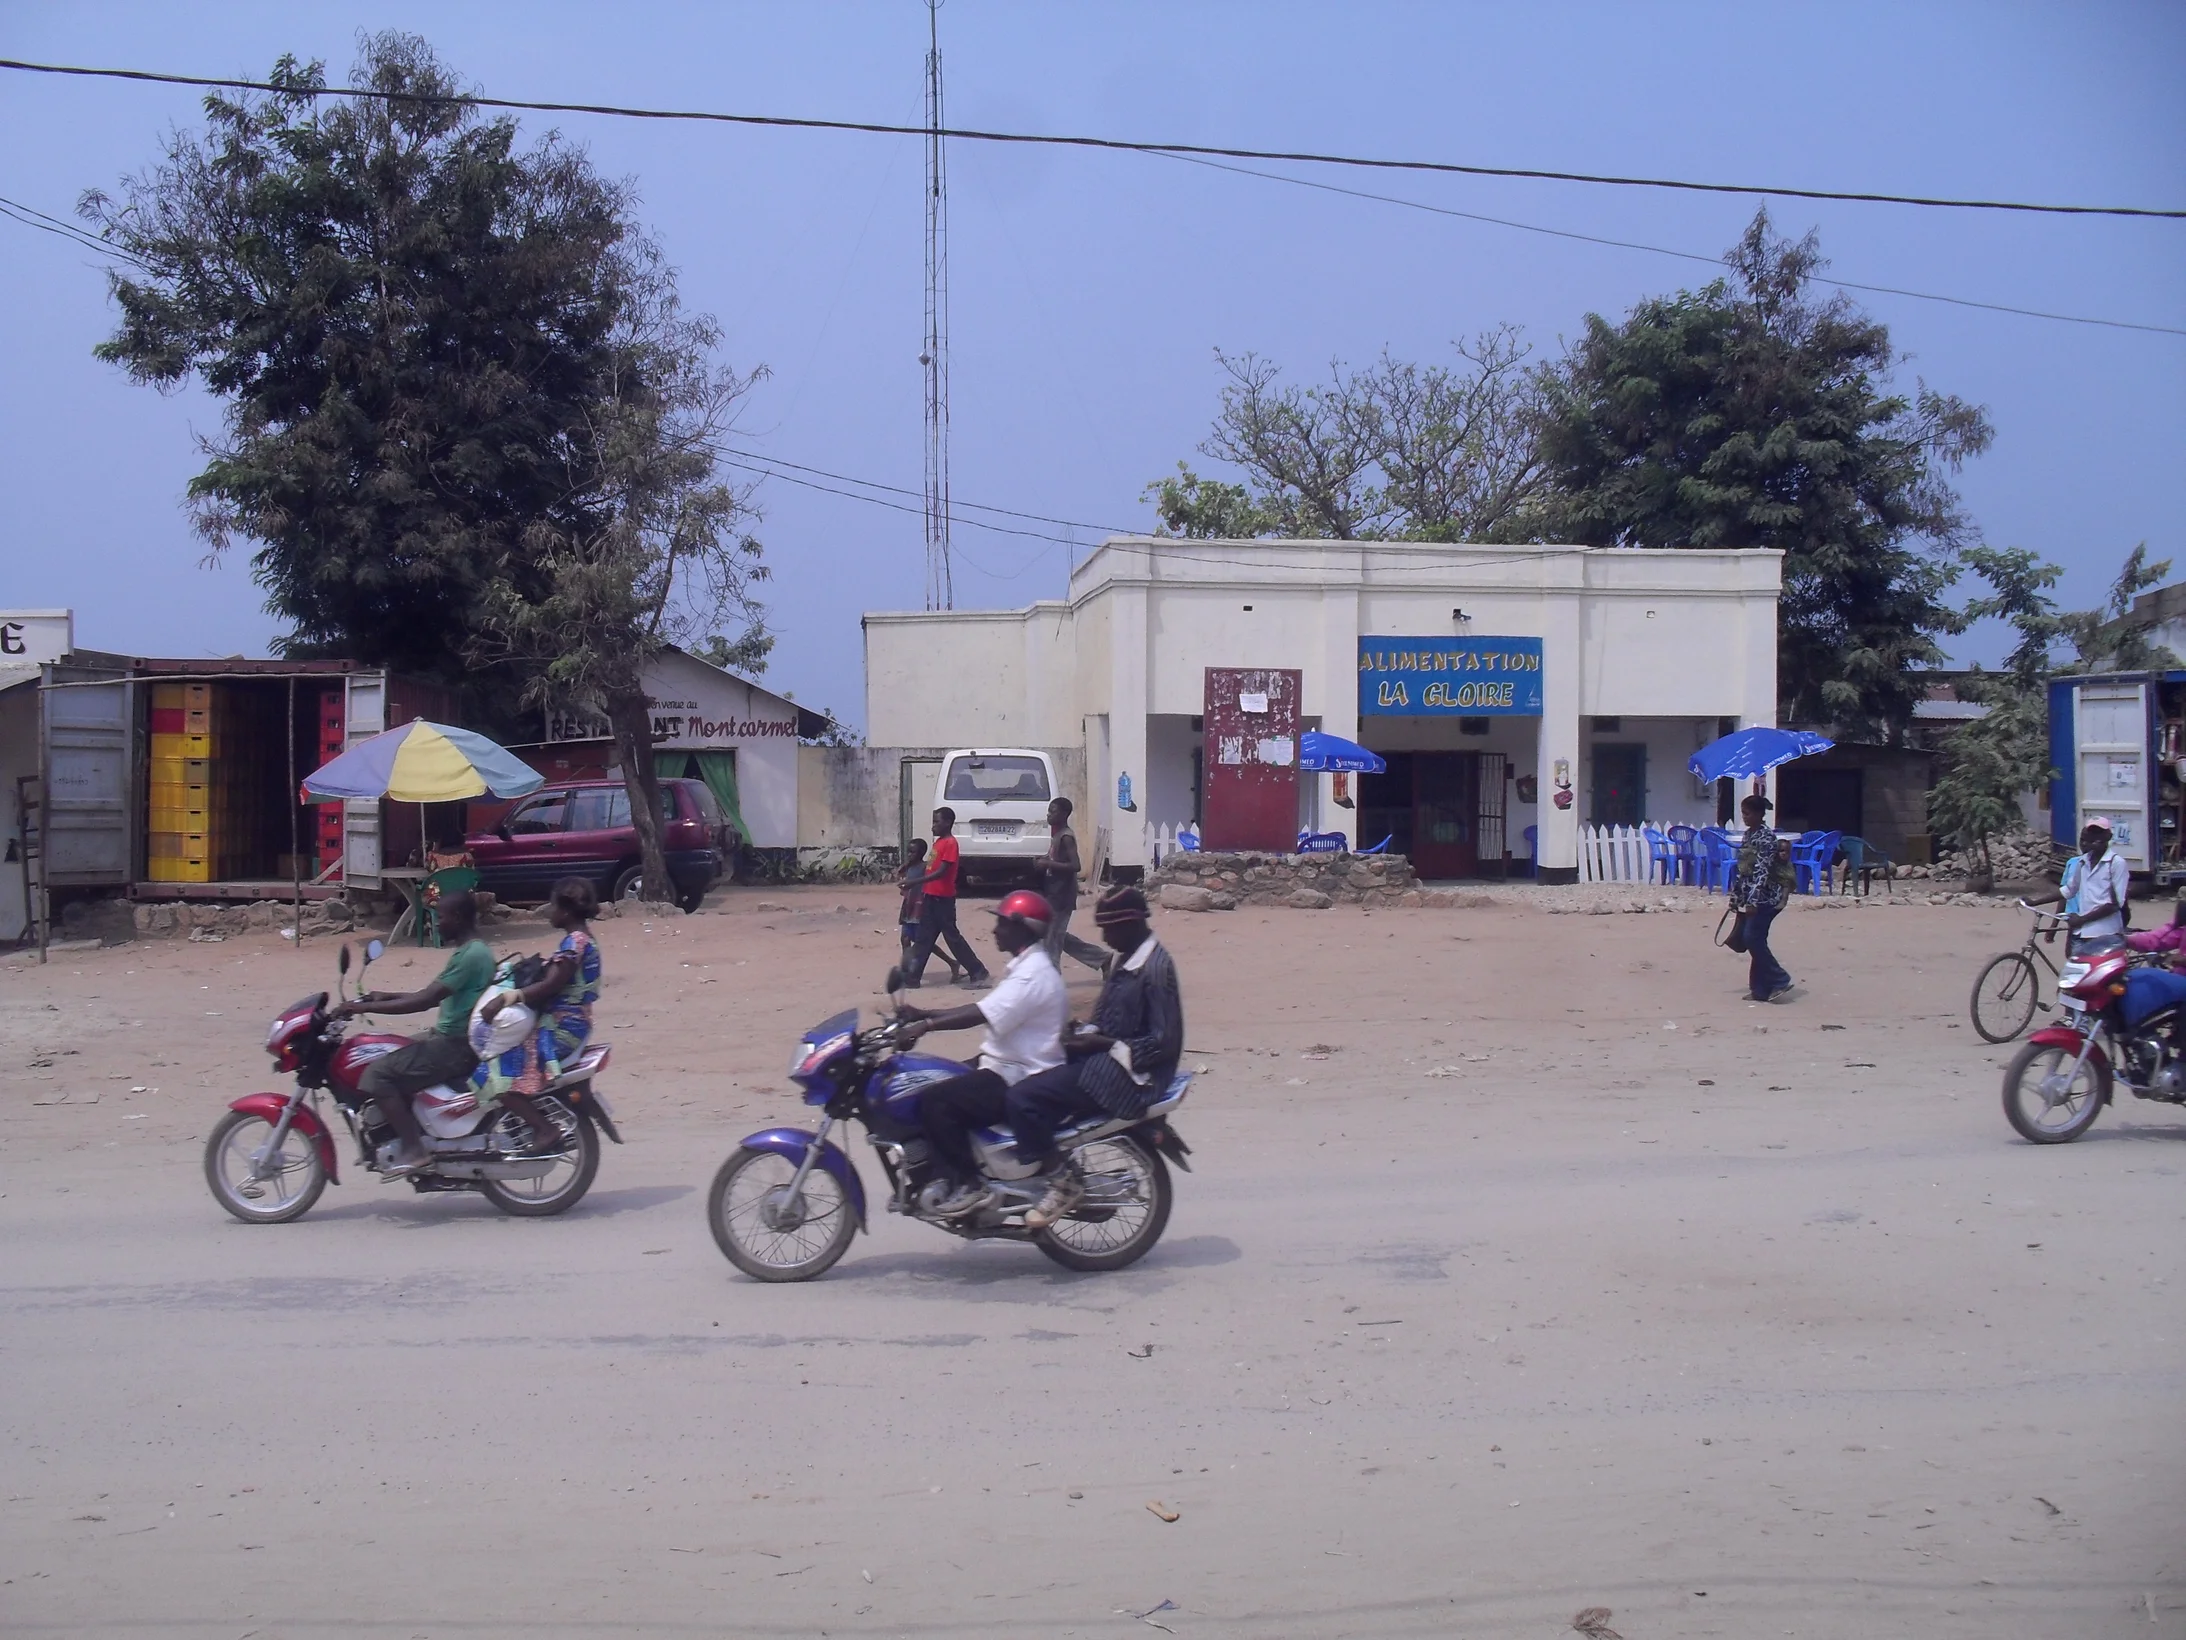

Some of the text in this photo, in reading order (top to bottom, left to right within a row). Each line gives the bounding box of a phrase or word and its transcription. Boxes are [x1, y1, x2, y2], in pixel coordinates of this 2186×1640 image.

[1359, 652, 1539, 672] ALIMENTATION
[1378, 681, 1409, 707] LA
[1422, 682, 1514, 708] GLOIRE
